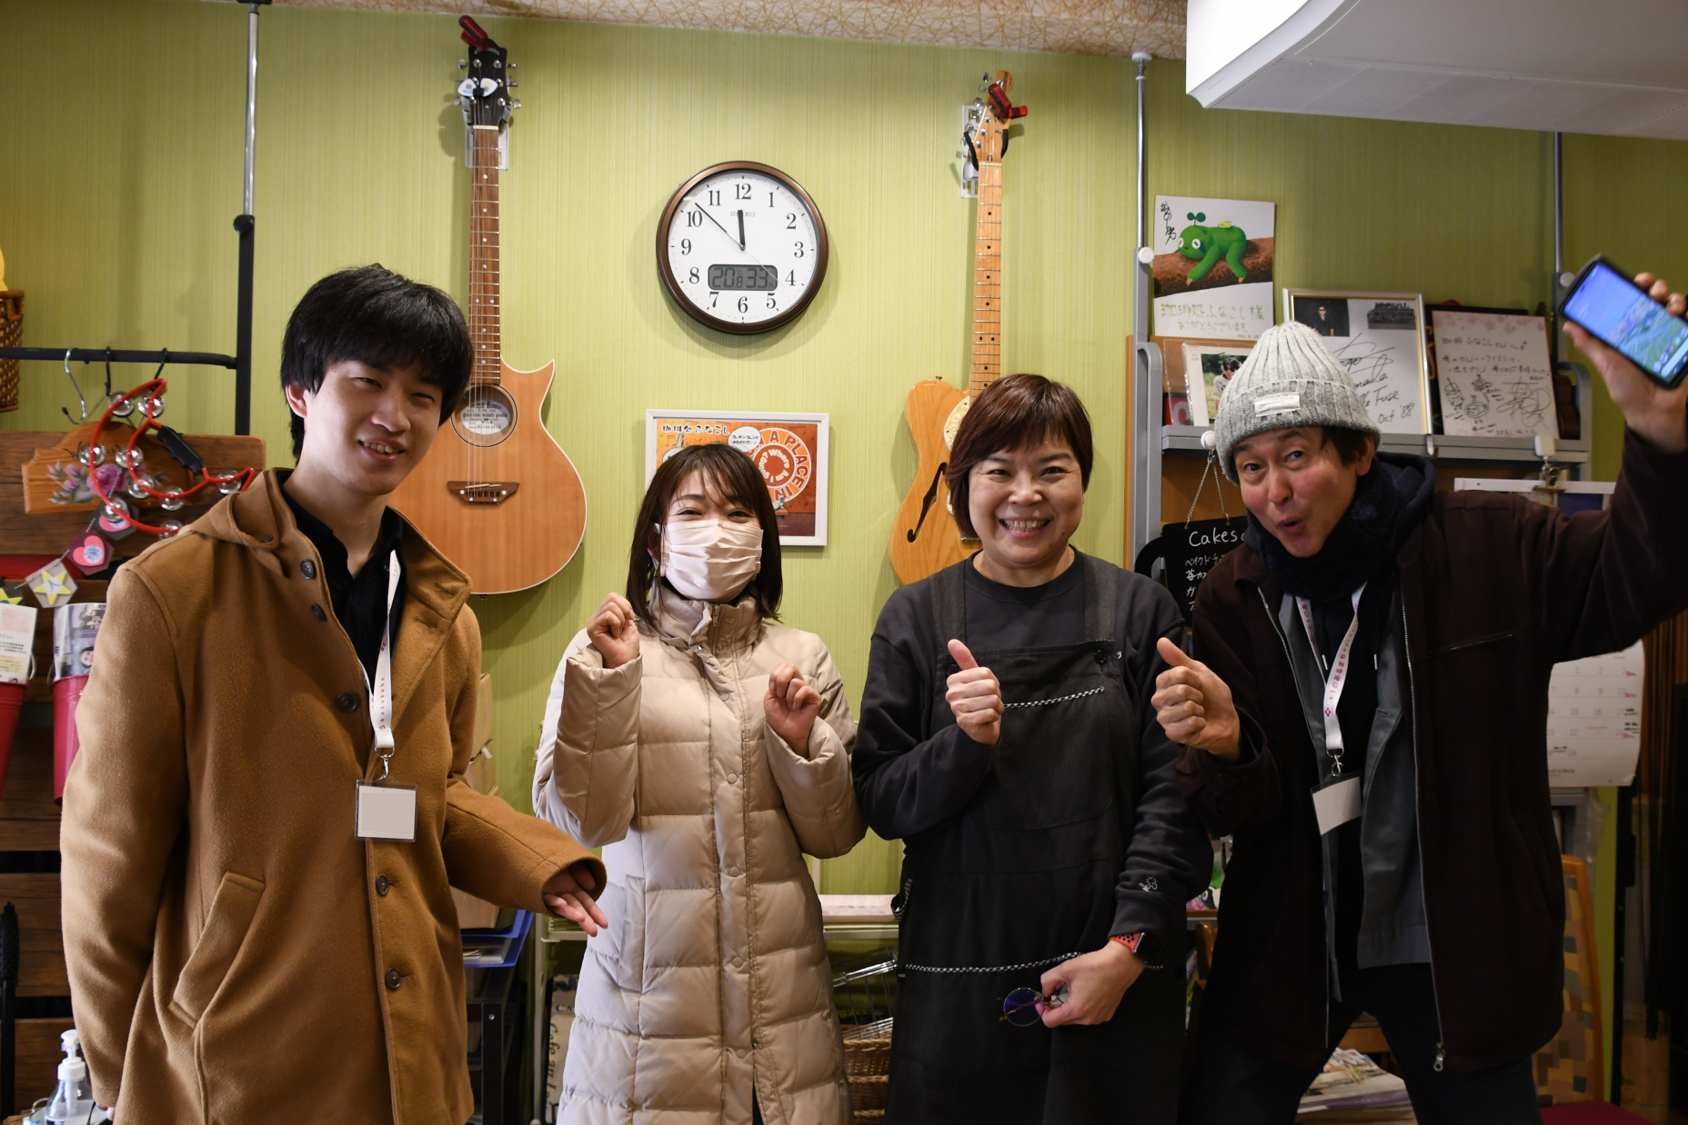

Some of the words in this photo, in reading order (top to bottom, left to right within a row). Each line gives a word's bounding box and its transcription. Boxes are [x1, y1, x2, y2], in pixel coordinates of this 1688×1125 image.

[708, 190, 721, 206] 11
[735, 183, 752, 200] 12
[768, 191, 775, 208] 1
[686, 210, 703, 228] 10
[786, 212, 797, 230] 2
[681, 238, 692, 256] 9
[794, 241, 804, 258] 3
[688, 267, 701, 284] 8
[785, 269, 797, 286] 4
[708, 291, 720, 308] 7
[737, 296, 749, 313] 6
[766, 292, 777, 309] 5
[768, 448, 790, 469] Where
[784, 434, 809, 489] PLACE
[775, 469, 789, 482] Am
[1188, 526, 1238, 547] Cakes
